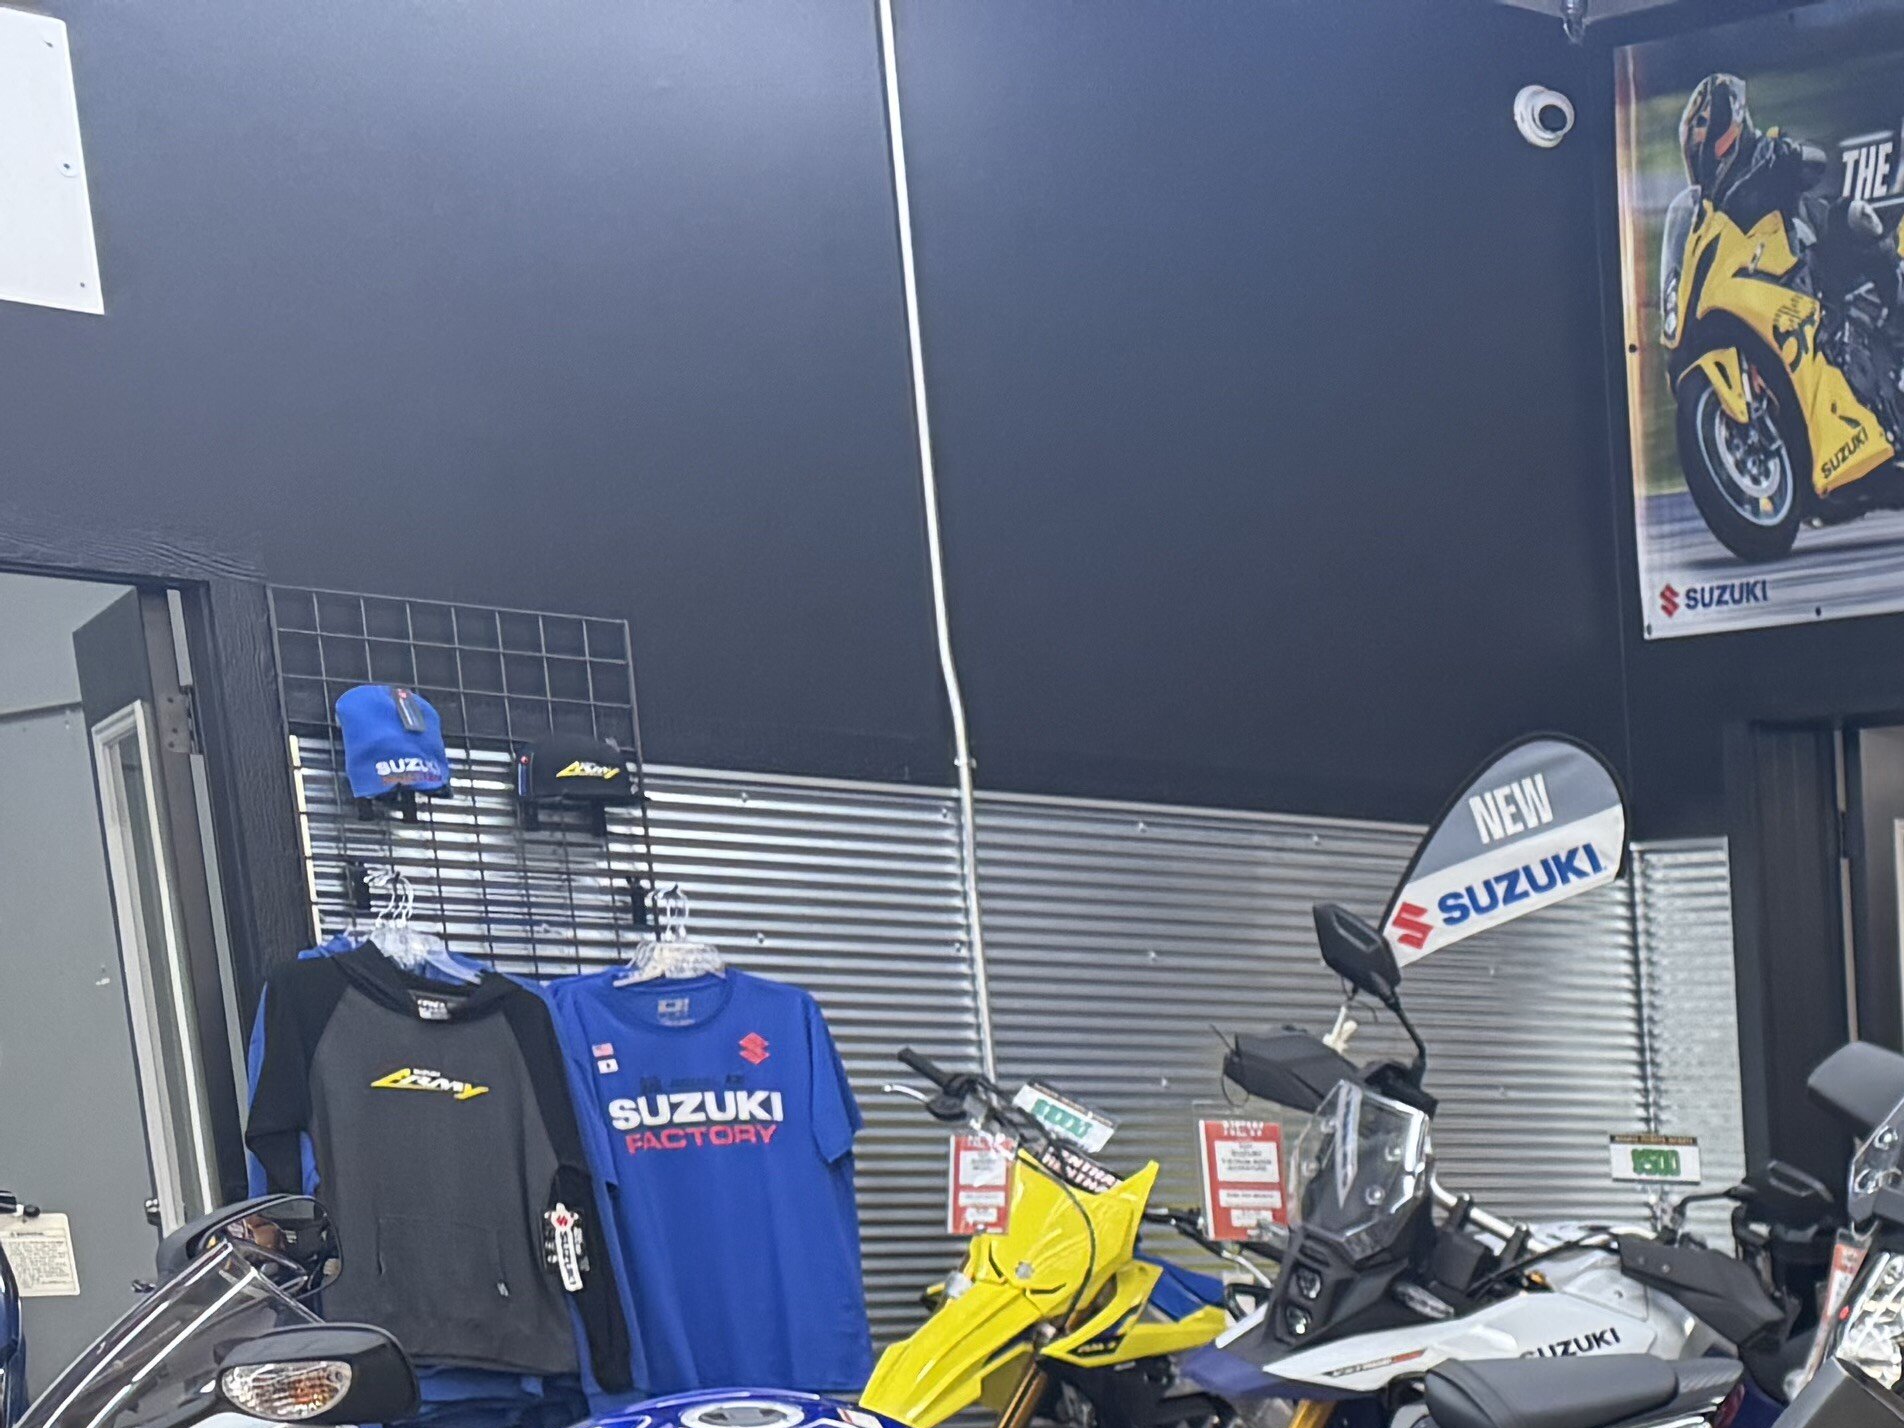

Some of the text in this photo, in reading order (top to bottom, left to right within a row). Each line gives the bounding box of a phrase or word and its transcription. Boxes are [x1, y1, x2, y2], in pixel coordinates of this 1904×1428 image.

[1842, 142, 1892, 200] THE
[1821, 429, 1868, 480] SUZUKI
[1685, 580, 1768, 609] SUZUKI
[375, 757, 441, 776] SUZUKI
[1469, 773, 1553, 844] NEW
[1438, 843, 1603, 926] SUZUKI
[608, 1091, 784, 1130] SUZUKI
[625, 1124, 777, 1155] FACTORY
